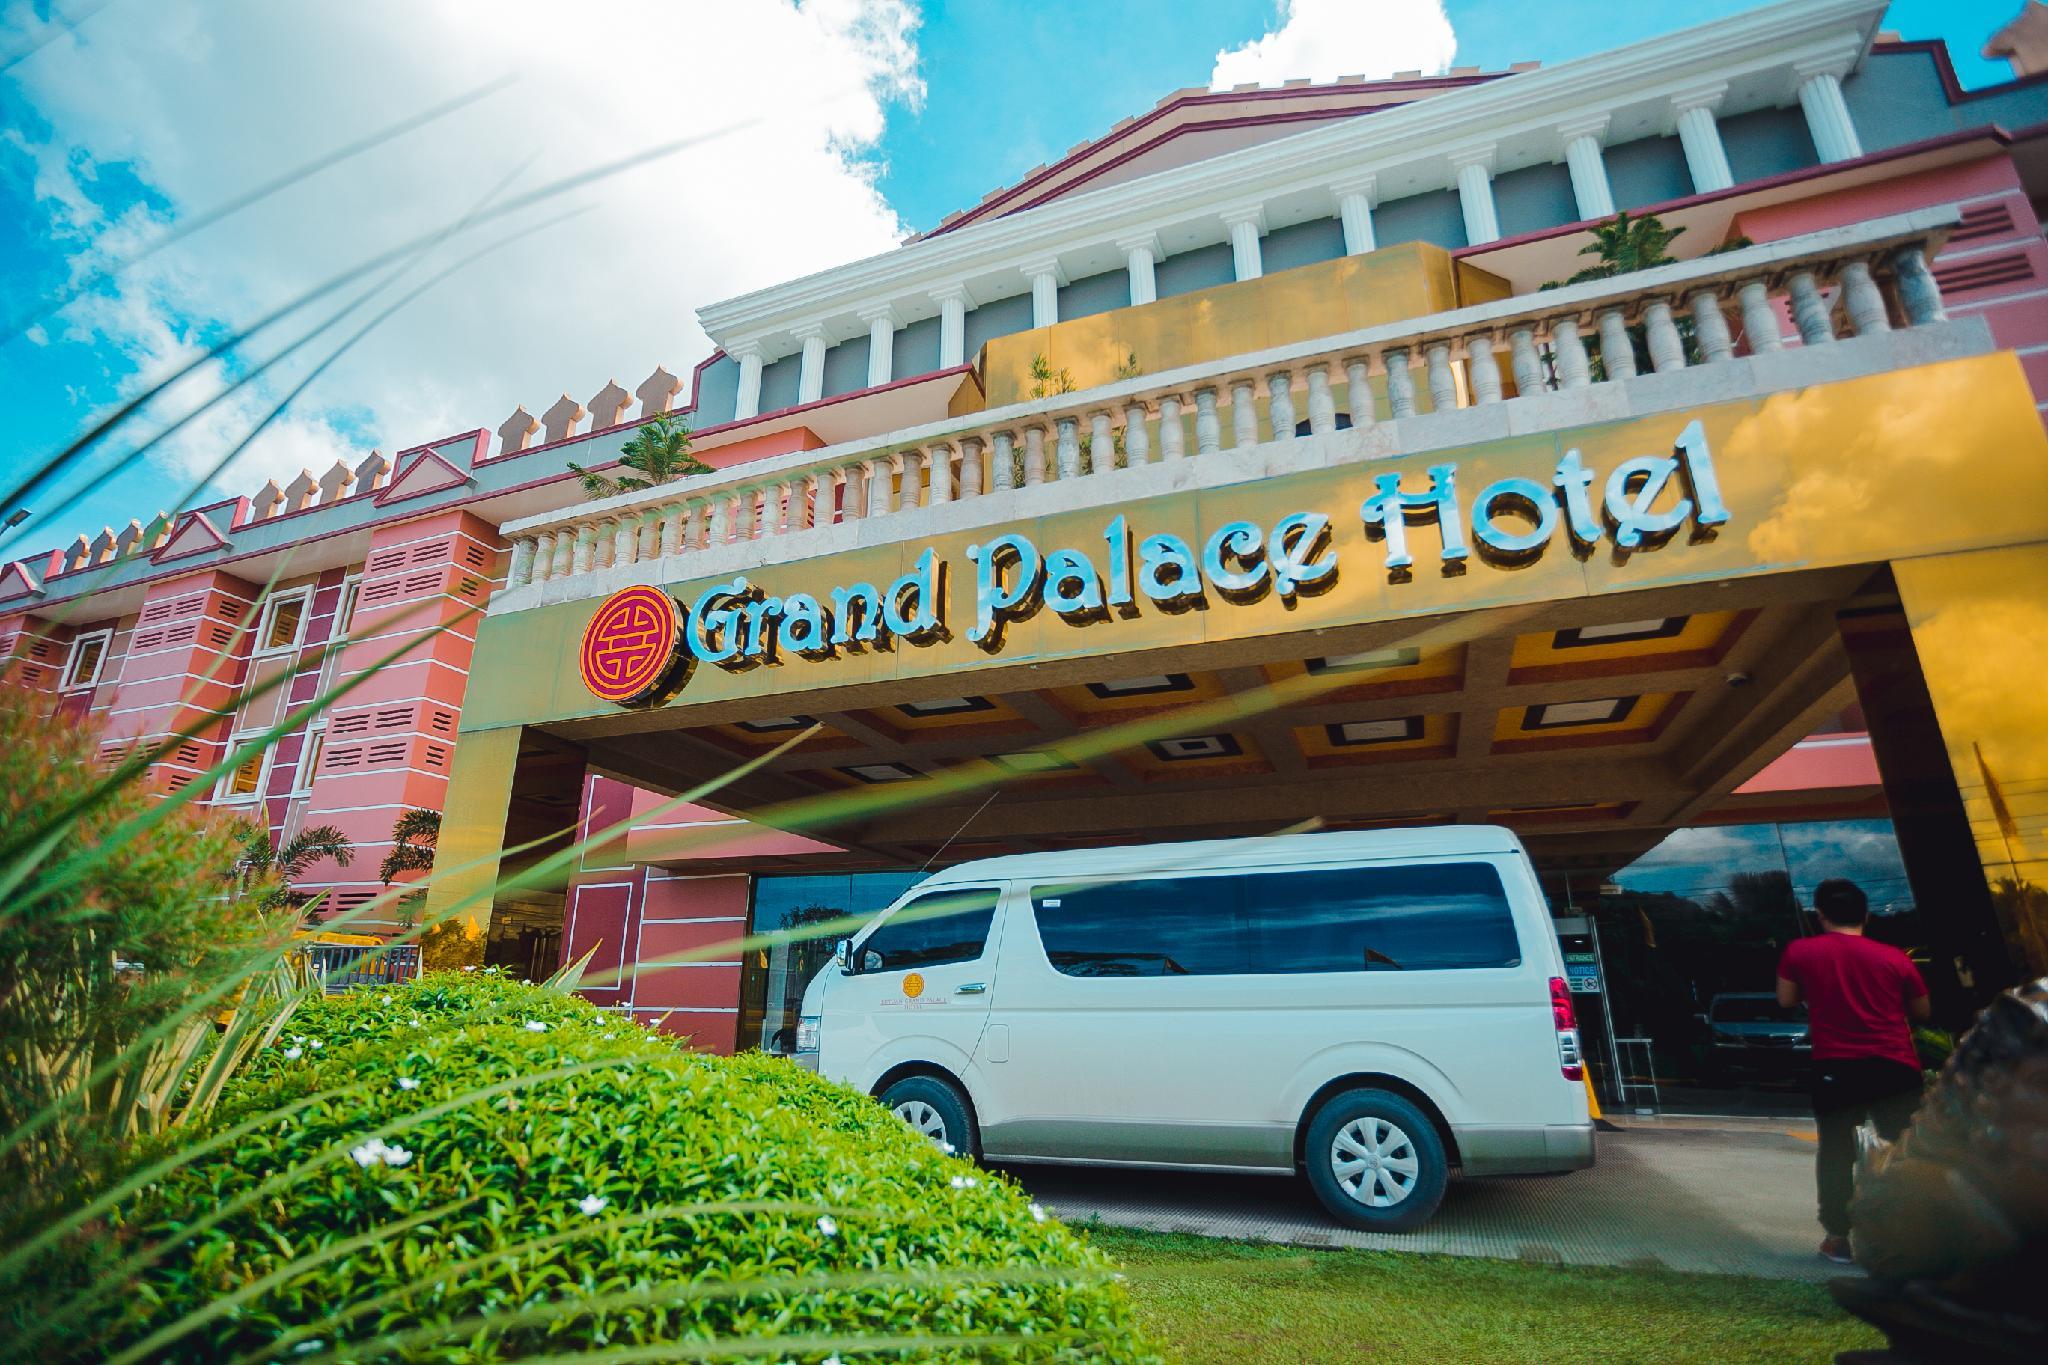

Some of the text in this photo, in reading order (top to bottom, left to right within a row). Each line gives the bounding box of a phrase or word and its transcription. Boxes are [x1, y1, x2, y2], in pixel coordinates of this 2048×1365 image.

[686, 419, 1731, 664] Grand Palace Hotel
[1569, 966, 1595, 975] NOTICE
